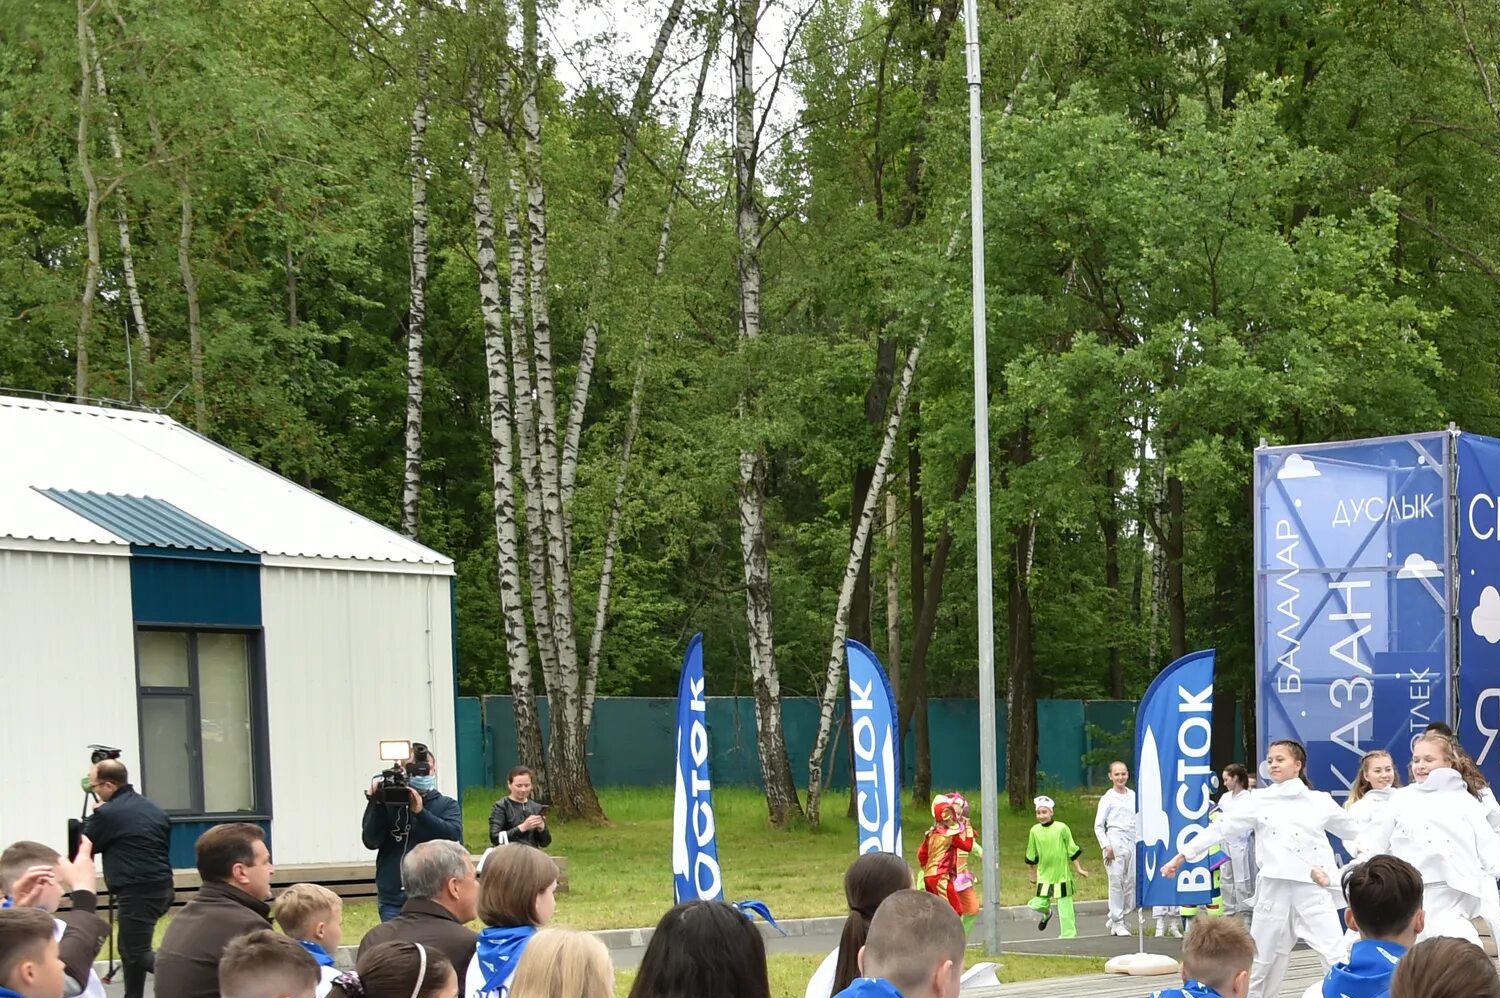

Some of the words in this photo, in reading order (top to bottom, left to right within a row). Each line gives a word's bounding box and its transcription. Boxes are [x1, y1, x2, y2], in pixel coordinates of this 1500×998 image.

[1332, 493, 1434, 527] ДУСЛЫК
[1276, 519, 1302, 694] БАЛАЛАР
[1176, 684, 1213, 893] ВОСТОК
